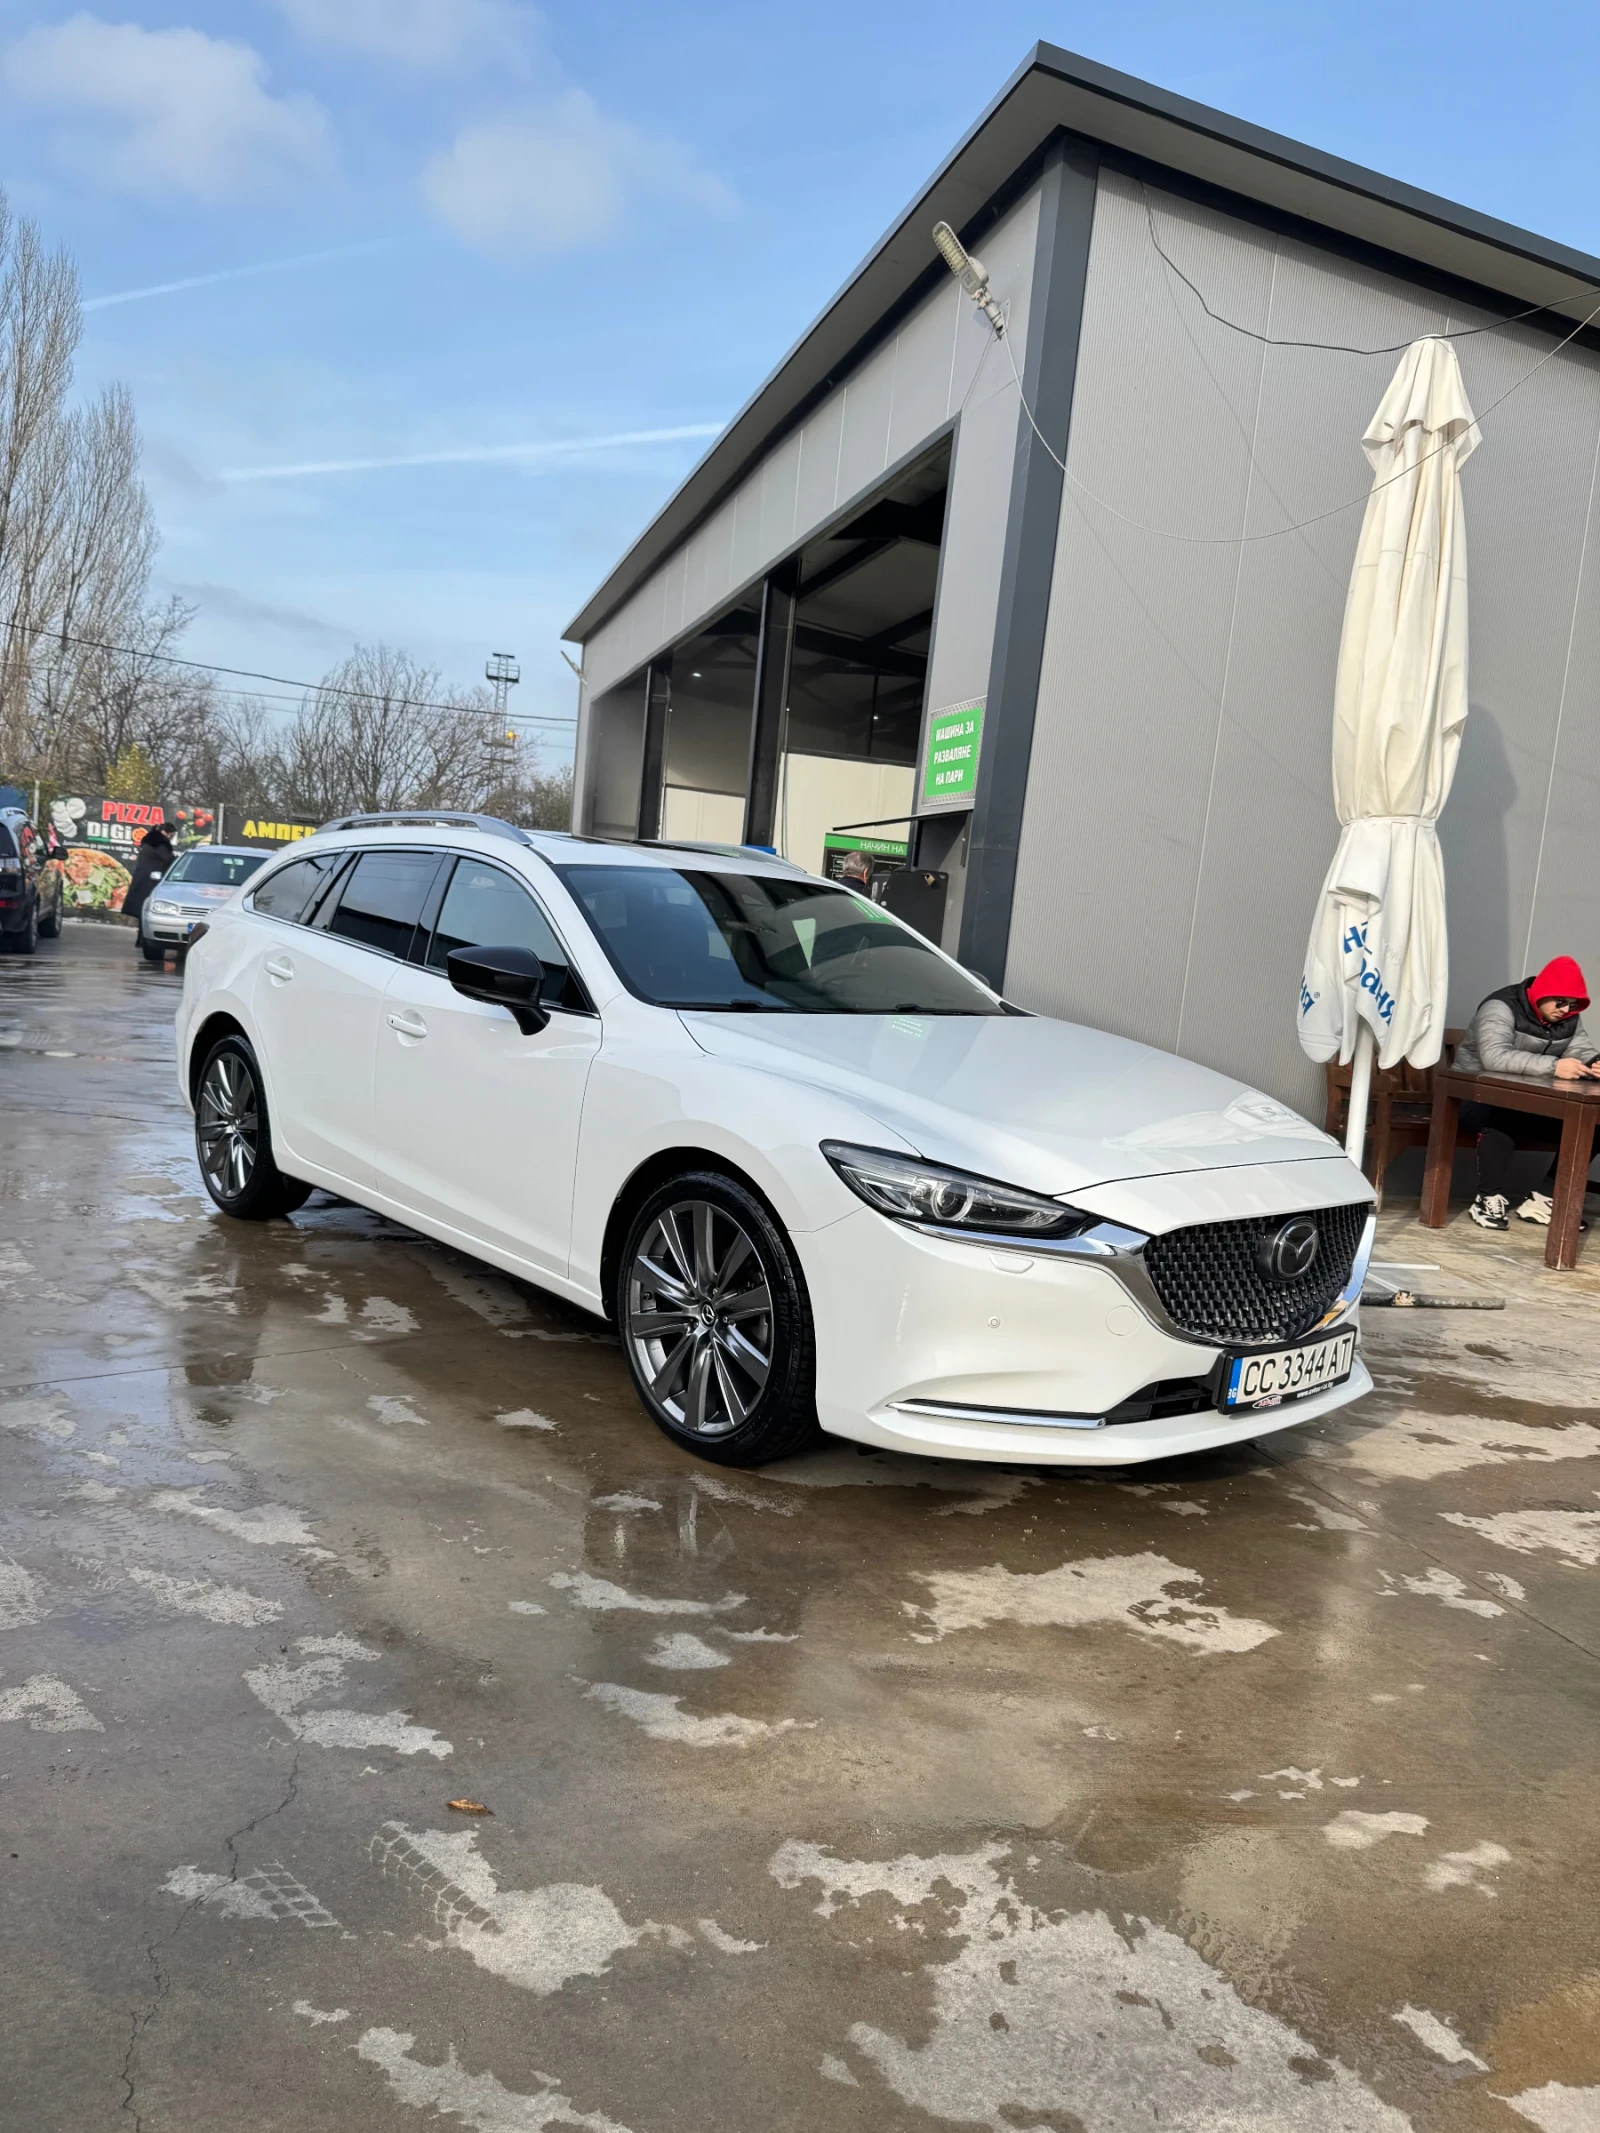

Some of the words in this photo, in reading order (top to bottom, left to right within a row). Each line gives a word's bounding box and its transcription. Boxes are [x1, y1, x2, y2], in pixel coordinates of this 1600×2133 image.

[936, 723, 964, 741] МАШИНА
[965, 720, 974, 734] ЗА
[934, 745, 971, 764] РАЗВАЛЯНЕ
[936, 772, 944, 785] НА
[946, 769, 963, 784] ПАРИ
[101, 800, 165, 826] PIZZA
[860, 841, 890, 852] НАЧИН
[891, 845, 904, 853] НА
[1243, 1358, 1276, 1396] CC
[1278, 1346, 1326, 1389] 3344
[1327, 1338, 1351, 1375] AT
